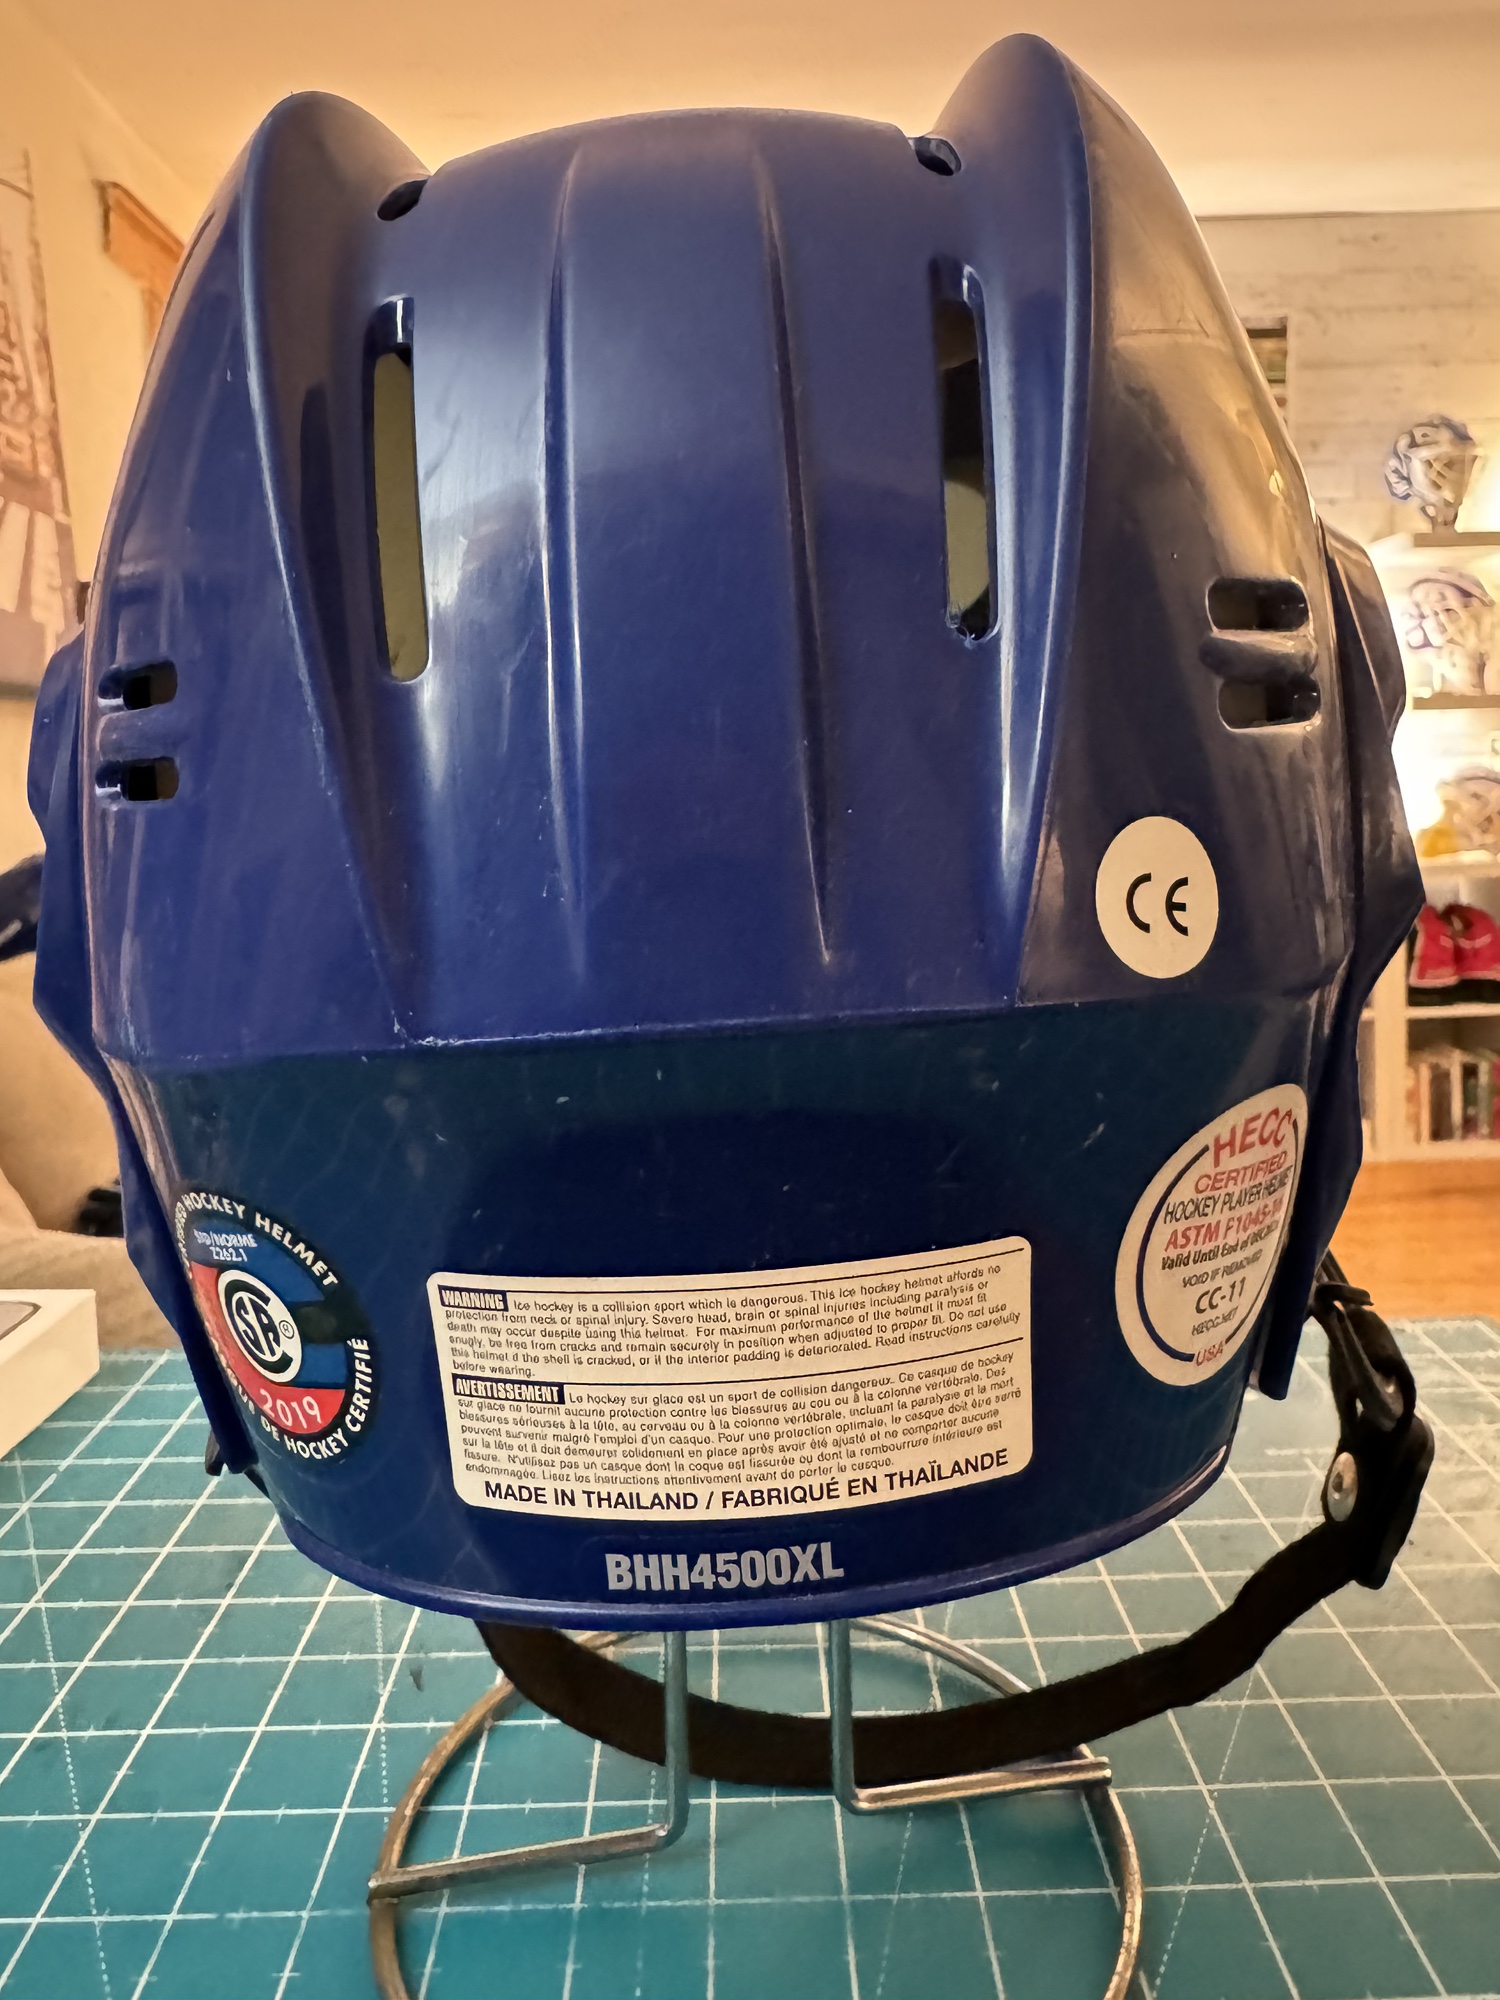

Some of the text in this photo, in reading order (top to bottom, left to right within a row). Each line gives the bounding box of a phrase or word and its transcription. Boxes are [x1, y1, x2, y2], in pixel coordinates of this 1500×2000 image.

[1126, 872, 1189, 937] CE
[1194, 1150, 1288, 1194] CERTIFIED
[1163, 1194, 1221, 1225] HOCKEY
[1220, 1182, 1263, 1215] PLAYER
[181, 1192, 339, 1287] HOCKEY HELMET
[1164, 1220, 1222, 1253] ASTM
[1192, 1245, 1221, 1265] Until
[441, 1289, 505, 1311] WARNING
[514, 1300, 530, 1310] Ice
[534, 1300, 573, 1313] hockey
[578, 1301, 587, 1311] is
[602, 1301, 650, 1311] collision
[654, 1300, 684, 1313] sport
[688, 1298, 722, 1309] which
[740, 1292, 807, 1309] dangerous.
[810, 1289, 835, 1301] This
[860, 1281, 900, 1298] hockey
[1182, 1271, 1210, 1289] VOID
[1195, 1276, 1248, 1315] CC-11
[224, 1278, 295, 1375] CSA
[506, 1328, 535, 1337] occur
[696, 1326, 715, 1336] For
[719, 1322, 776, 1335] maximum
[576, 1315, 609, 1327] spinal
[614, 1315, 648, 1327] injury.
[652, 1313, 693, 1324] Severe
[697, 1311, 731, 1324] head,
[735, 1308, 764, 1320] brain
[784, 1303, 819, 1318] spinal
[824, 1297, 865, 1314] injuries
[560, 1341, 596, 1351] cracks
[601, 1342, 622, 1351] and
[788, 1331, 819, 1344] when
[823, 1325, 872, 1342] adjusted
[586, 1355, 635, 1366] cracked,
[665, 1355, 683, 1365] the
[687, 1352, 729, 1364] interior
[733, 1349, 780, 1364] padding
[875, 1334, 904, 1347] Read
[909, 1322, 972, 1342] instructions
[1195, 1341, 1225, 1367] USA
[260, 1337, 374, 1461] DE HOCKEY CERTIFIÉ
[456, 1377, 560, 1404] AVERTISSEMENT
[586, 1394, 626, 1407] hockey
[652, 1394, 683, 1406] glace
[708, 1394, 723, 1402] un
[728, 1390, 757, 1404] sport
[761, 1389, 776, 1400] de
[780, 1385, 826, 1398] collision
[960, 1359, 973, 1371] de
[259, 1388, 323, 1430] 2019
[609, 1408, 666, 1420] protection
[670, 1407, 706, 1417] contre
[877, 1384, 921, 1400] colonne
[579, 1420, 589, 1430] la
[719, 1419, 730, 1429] la
[734, 1416, 779, 1428] colonne
[717, 1431, 744, 1442] Pour
[774, 1423, 831, 1441] protection
[559, 1460, 578, 1471] pas
[583, 1461, 596, 1470] un
[600, 1462, 641, 1473] casque
[688, 1461, 723, 1473] coque
[817, 1449, 842, 1461] dont
[706, 1446, 737, 1459] place
[778, 1440, 805, 1452] avoir
[484, 1448, 1010, 1511] MADE IN THAILAND / FABRIQUÉ EN THAÏLANDE
[605, 1541, 845, 1591] BHH4500XL
